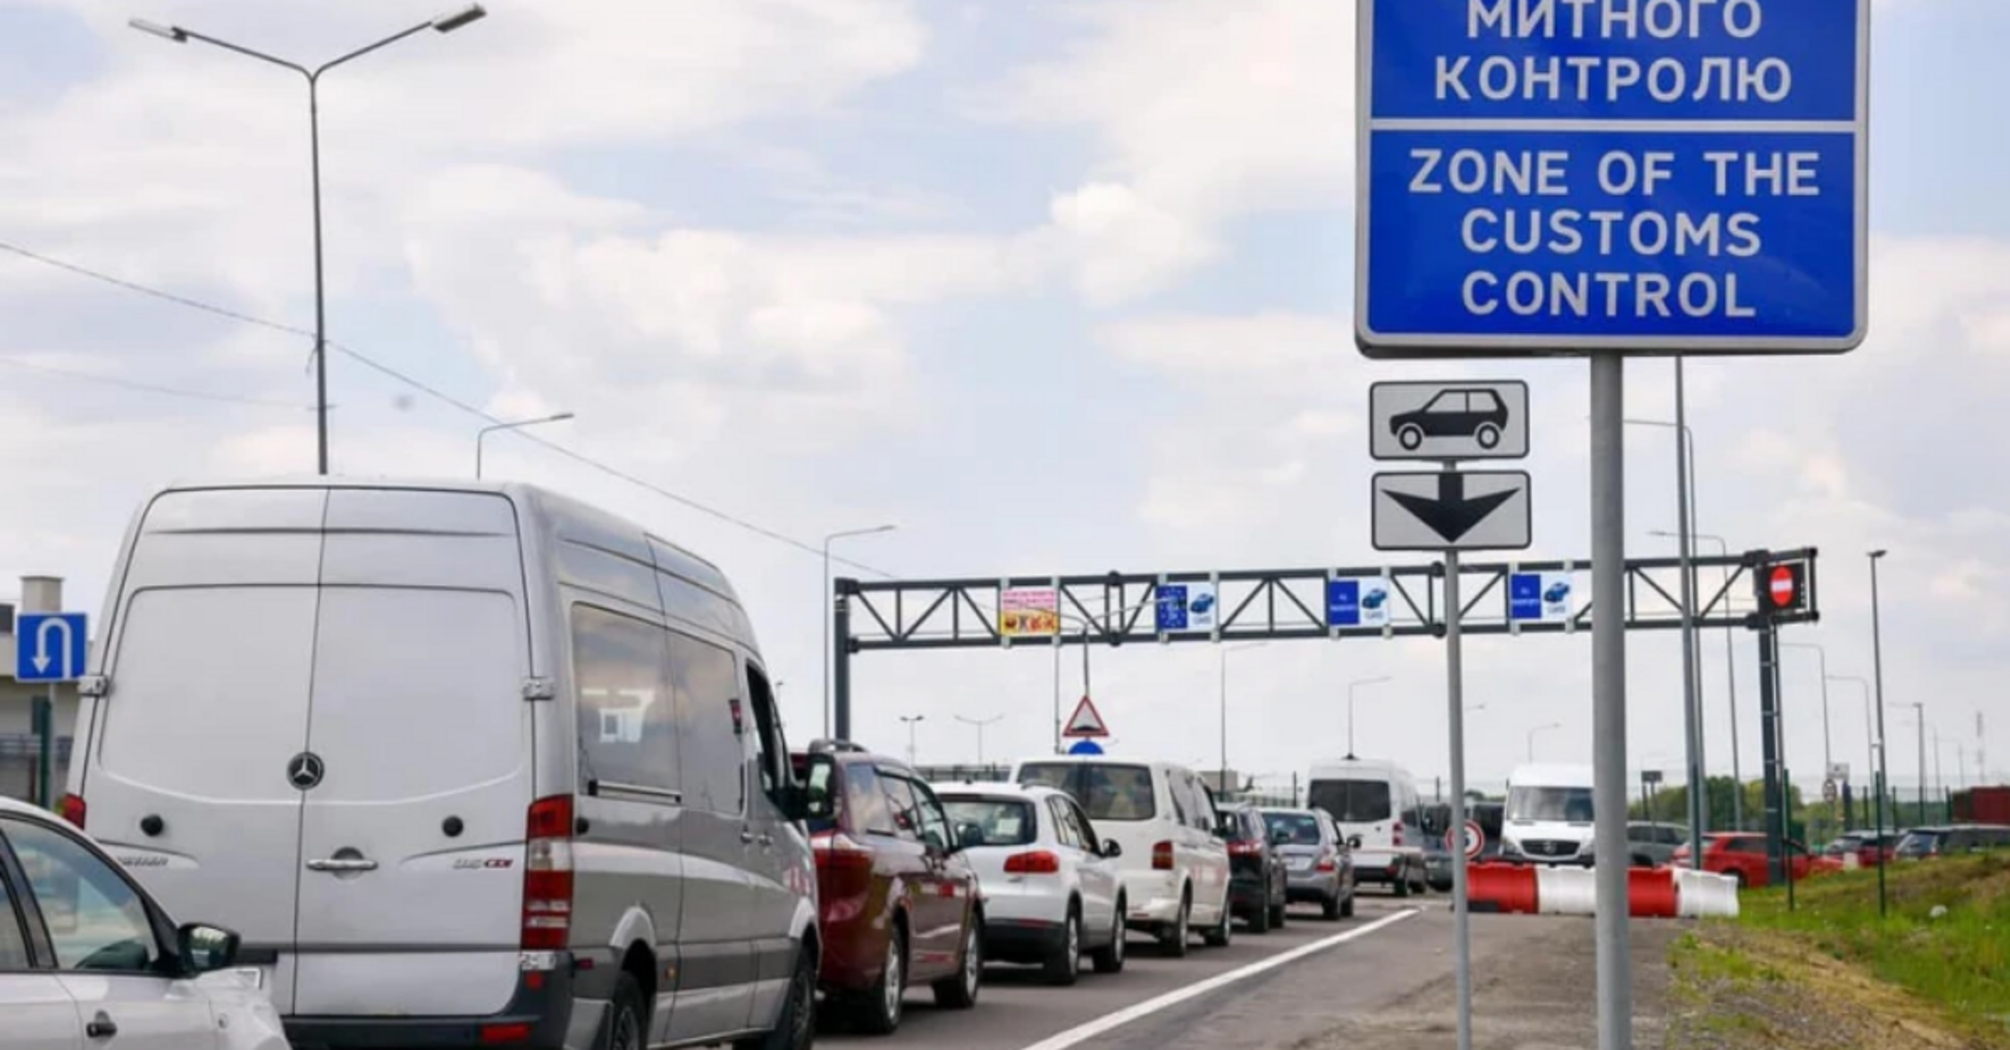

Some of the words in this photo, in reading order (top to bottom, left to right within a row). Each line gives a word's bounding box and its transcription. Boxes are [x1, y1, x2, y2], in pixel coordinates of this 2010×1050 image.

[1469, 0, 1761, 38] МИТНОГО
[1437, 56, 1791, 101] КОНТРОЛЮ
[1410, 150, 1568, 194] ZONE
[1599, 151, 1673, 195] OF
[1704, 152, 1818, 195] THE
[1463, 209, 1760, 256] CUSTOMS
[1463, 271, 1754, 316] CONTROL
